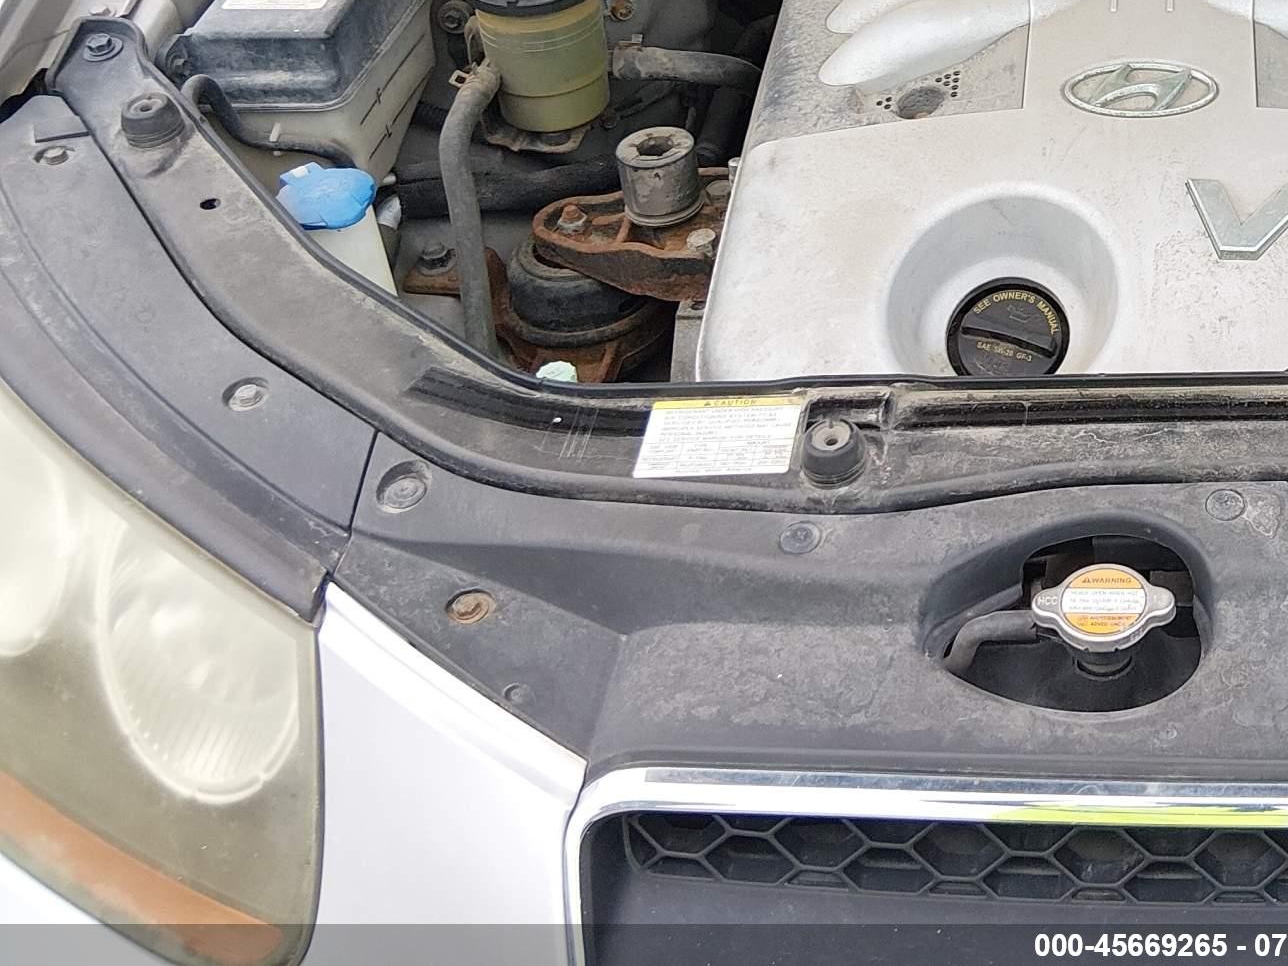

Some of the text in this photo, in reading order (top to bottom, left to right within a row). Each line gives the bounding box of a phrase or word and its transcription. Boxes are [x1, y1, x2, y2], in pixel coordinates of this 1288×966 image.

[973, 291, 1060, 335] SEE OWNER'S MANUAL
[976, 341, 992, 352] SAE
[1016, 351, 1033, 362] GF-3
[1037, 595, 1058, 606] HCC
